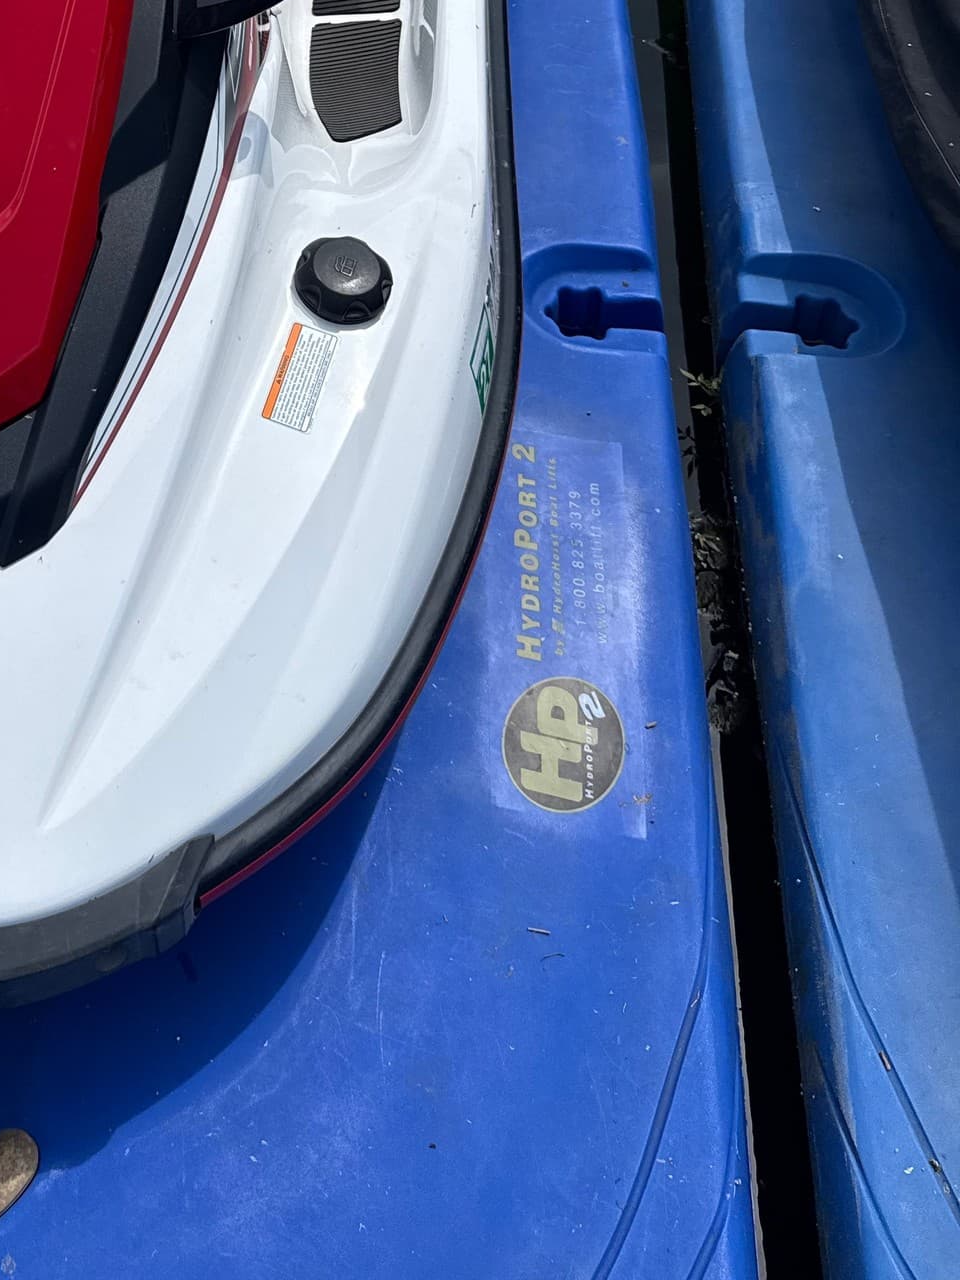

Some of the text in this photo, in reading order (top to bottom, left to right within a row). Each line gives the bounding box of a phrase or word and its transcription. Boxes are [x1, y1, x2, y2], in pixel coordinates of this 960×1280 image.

[277, 355, 290, 379] WARNING
[511, 443, 537, 464] 2
[546, 457, 558, 490] Lifts
[549, 496, 560, 527] Boat
[554, 639, 565, 656] by
[578, 690, 606, 721] 2
[520, 686, 598, 802] HP
